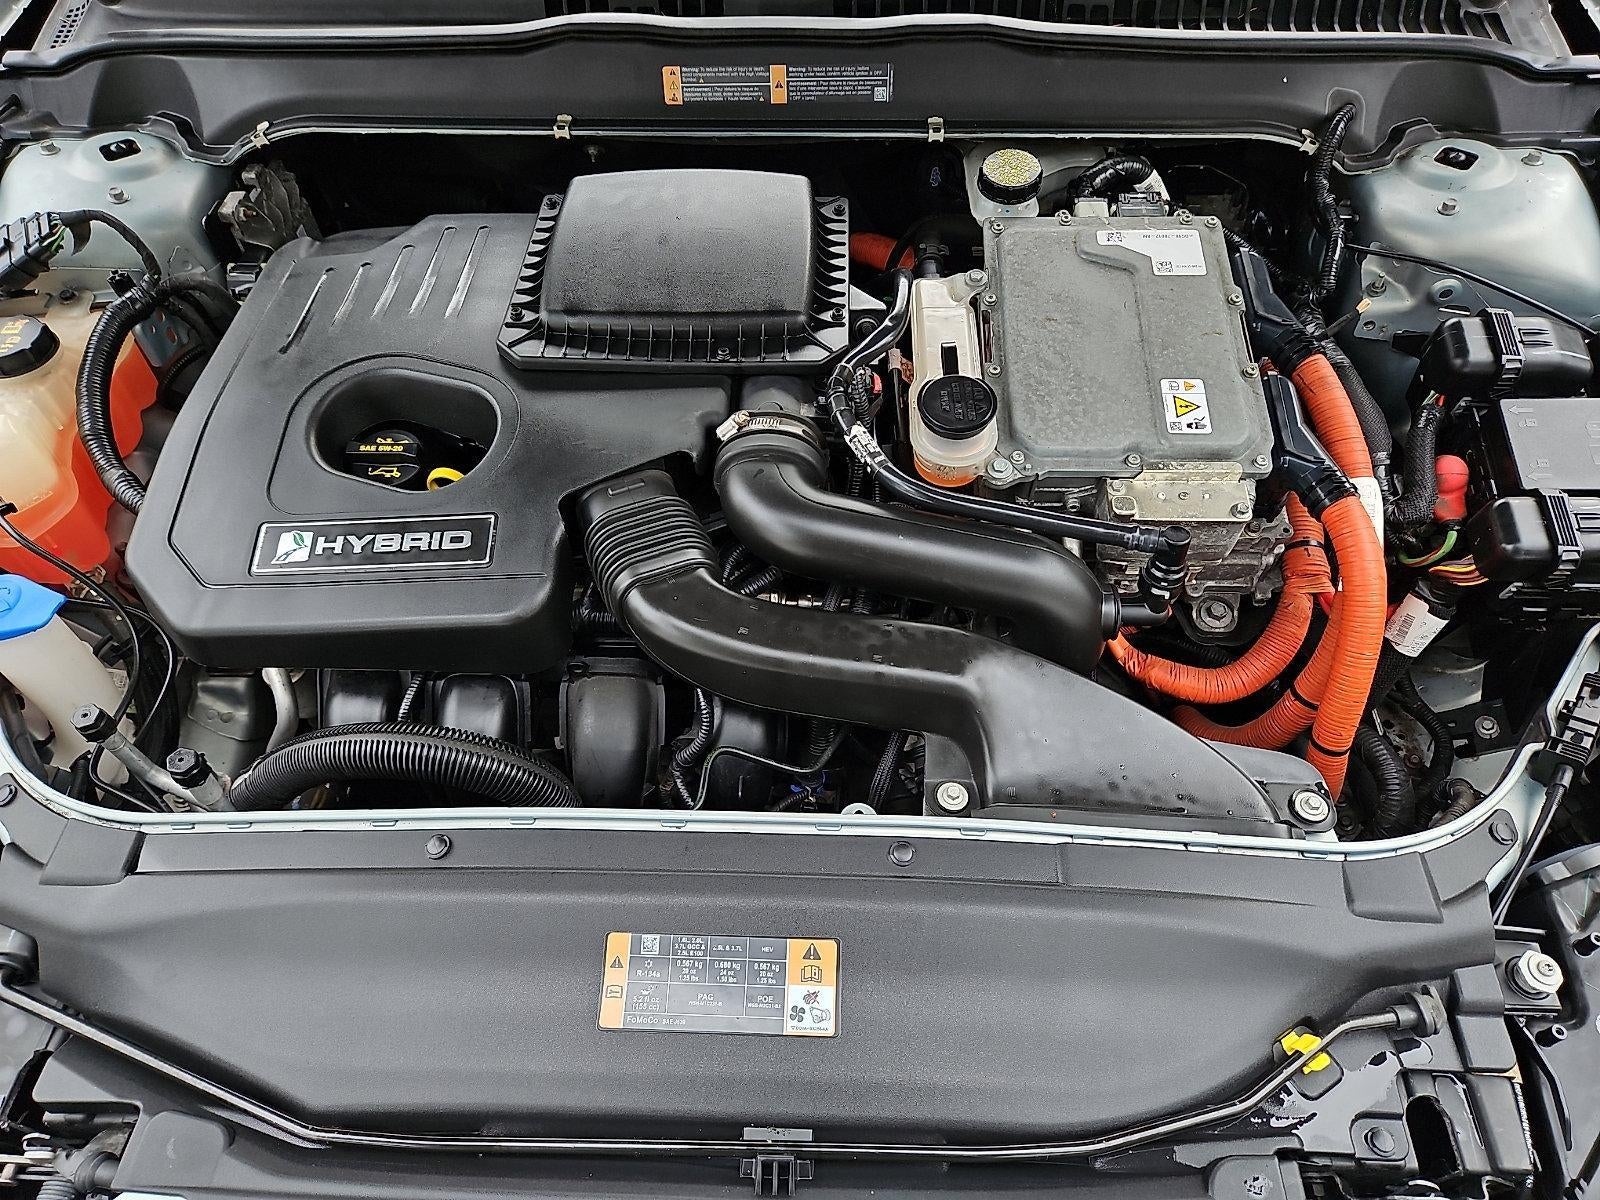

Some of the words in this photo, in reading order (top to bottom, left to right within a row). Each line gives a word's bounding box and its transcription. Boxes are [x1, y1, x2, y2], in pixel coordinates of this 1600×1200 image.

[314, 530, 472, 555] HYBRID
[694, 961, 702, 969] kg
[772, 964, 780, 972] kg
[626, 1016, 659, 1024] FoMoCo
